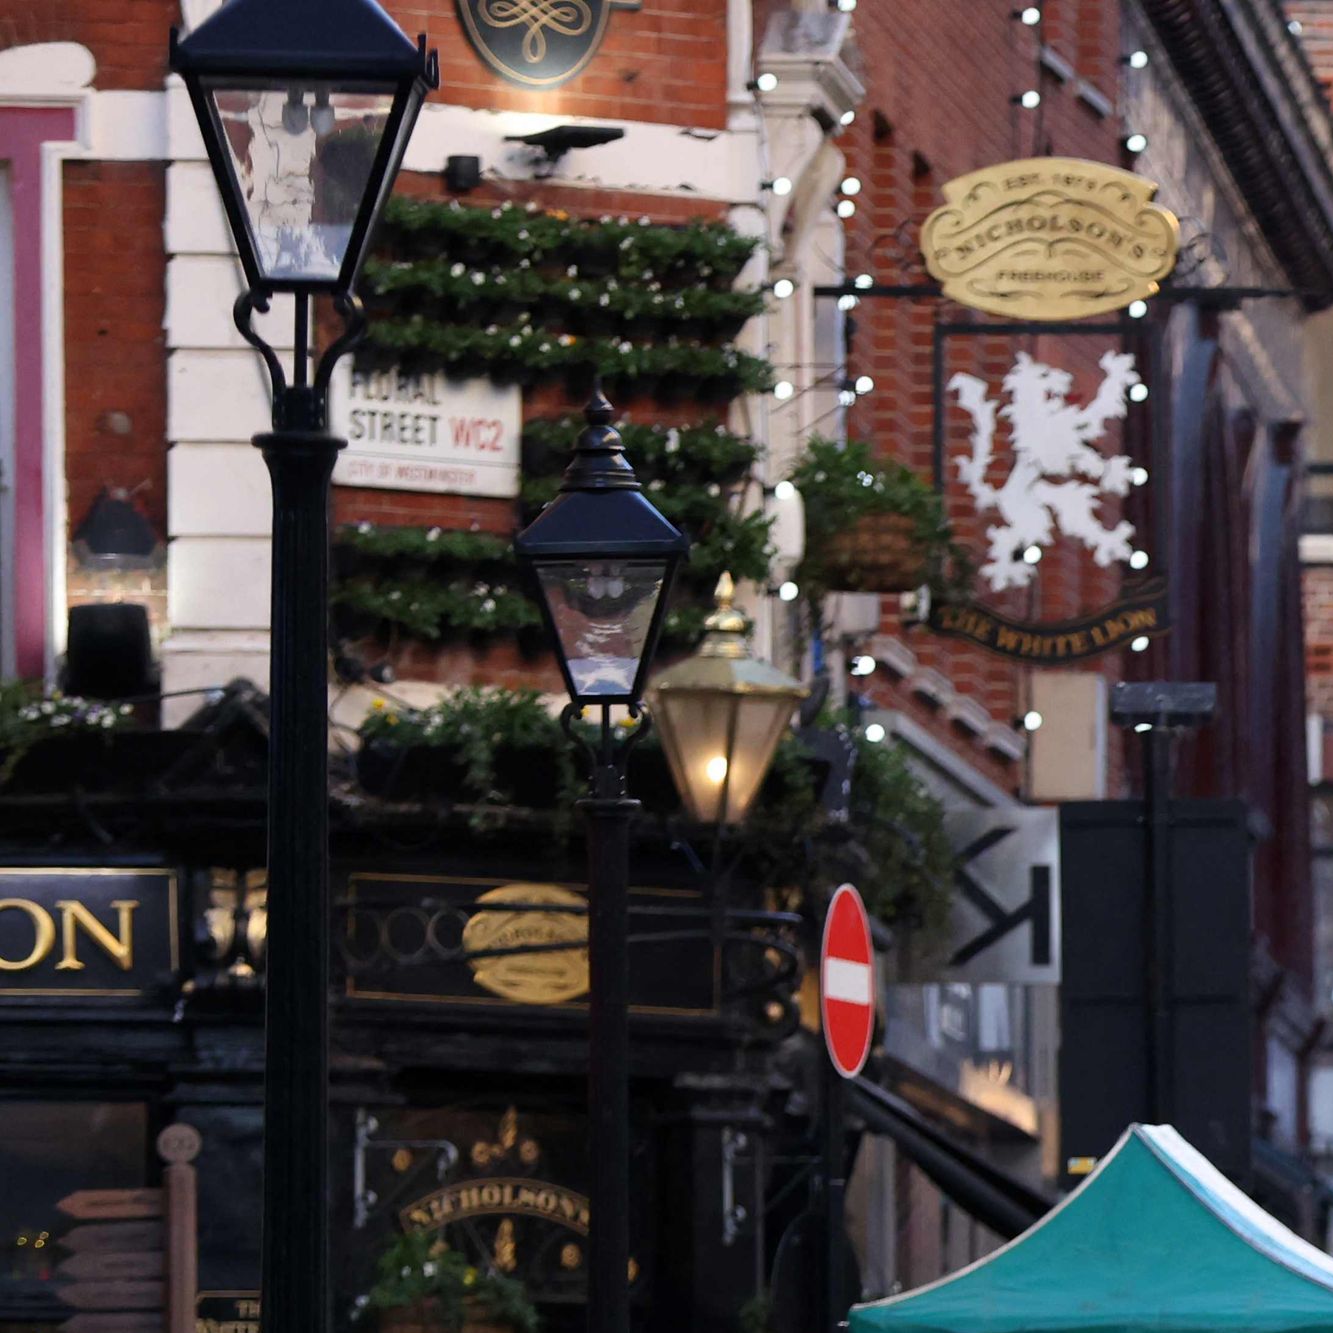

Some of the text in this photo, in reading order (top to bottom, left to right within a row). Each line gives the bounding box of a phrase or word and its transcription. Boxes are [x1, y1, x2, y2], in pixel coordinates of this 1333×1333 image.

[955, 214, 1147, 260] NICHOLSON'S
[350, 409, 503, 452] STREET WC2
[996, 624, 1088, 657] WHITE
[1090, 606, 1157, 647] LION
